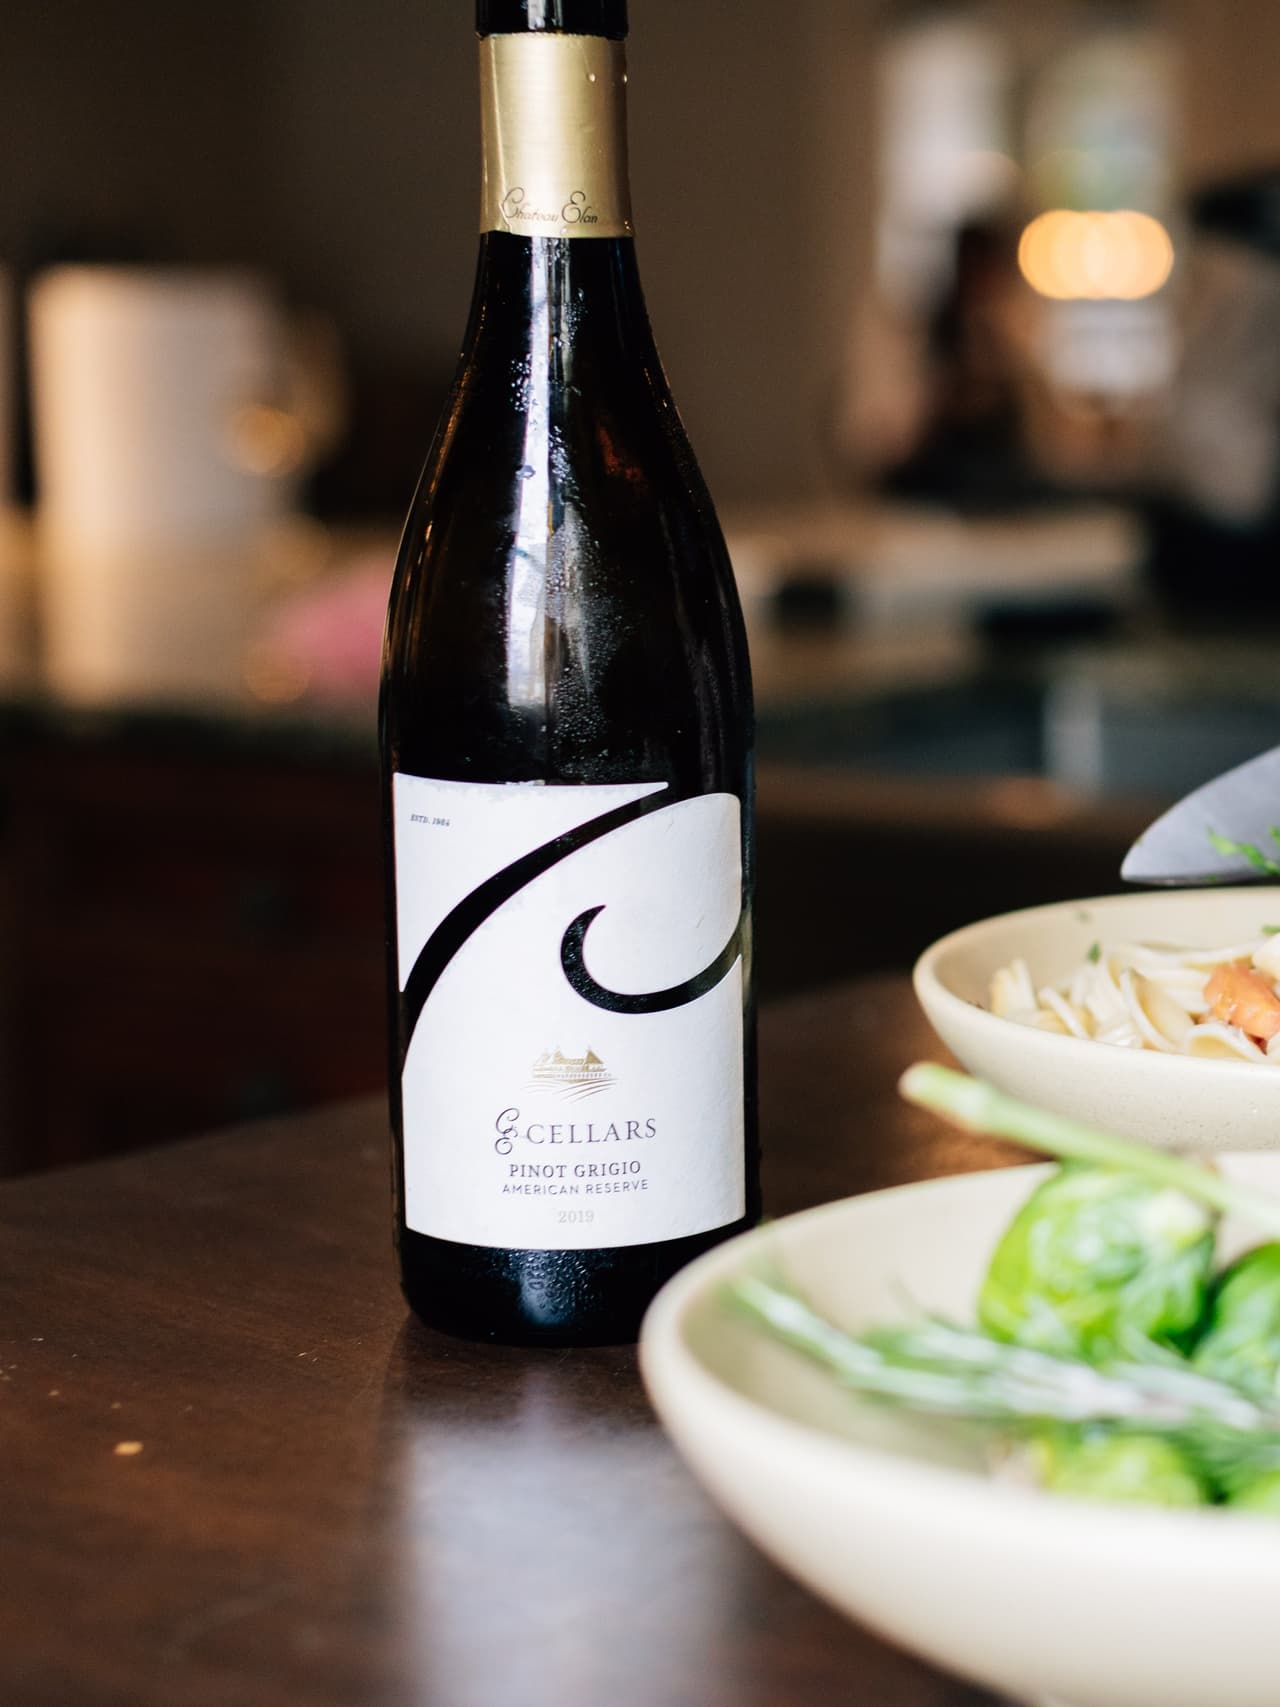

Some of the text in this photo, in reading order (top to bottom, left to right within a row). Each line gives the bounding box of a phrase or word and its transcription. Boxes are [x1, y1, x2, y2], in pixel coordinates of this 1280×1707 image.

[561, 191, 599, 224] Elan
[526, 1117, 657, 1145] CELLARS
[509, 1160, 642, 1179] PINOT GRIGIO
[502, 1178, 649, 1196] AMERICAN RESERVE
[558, 1209, 595, 1224] 2019
